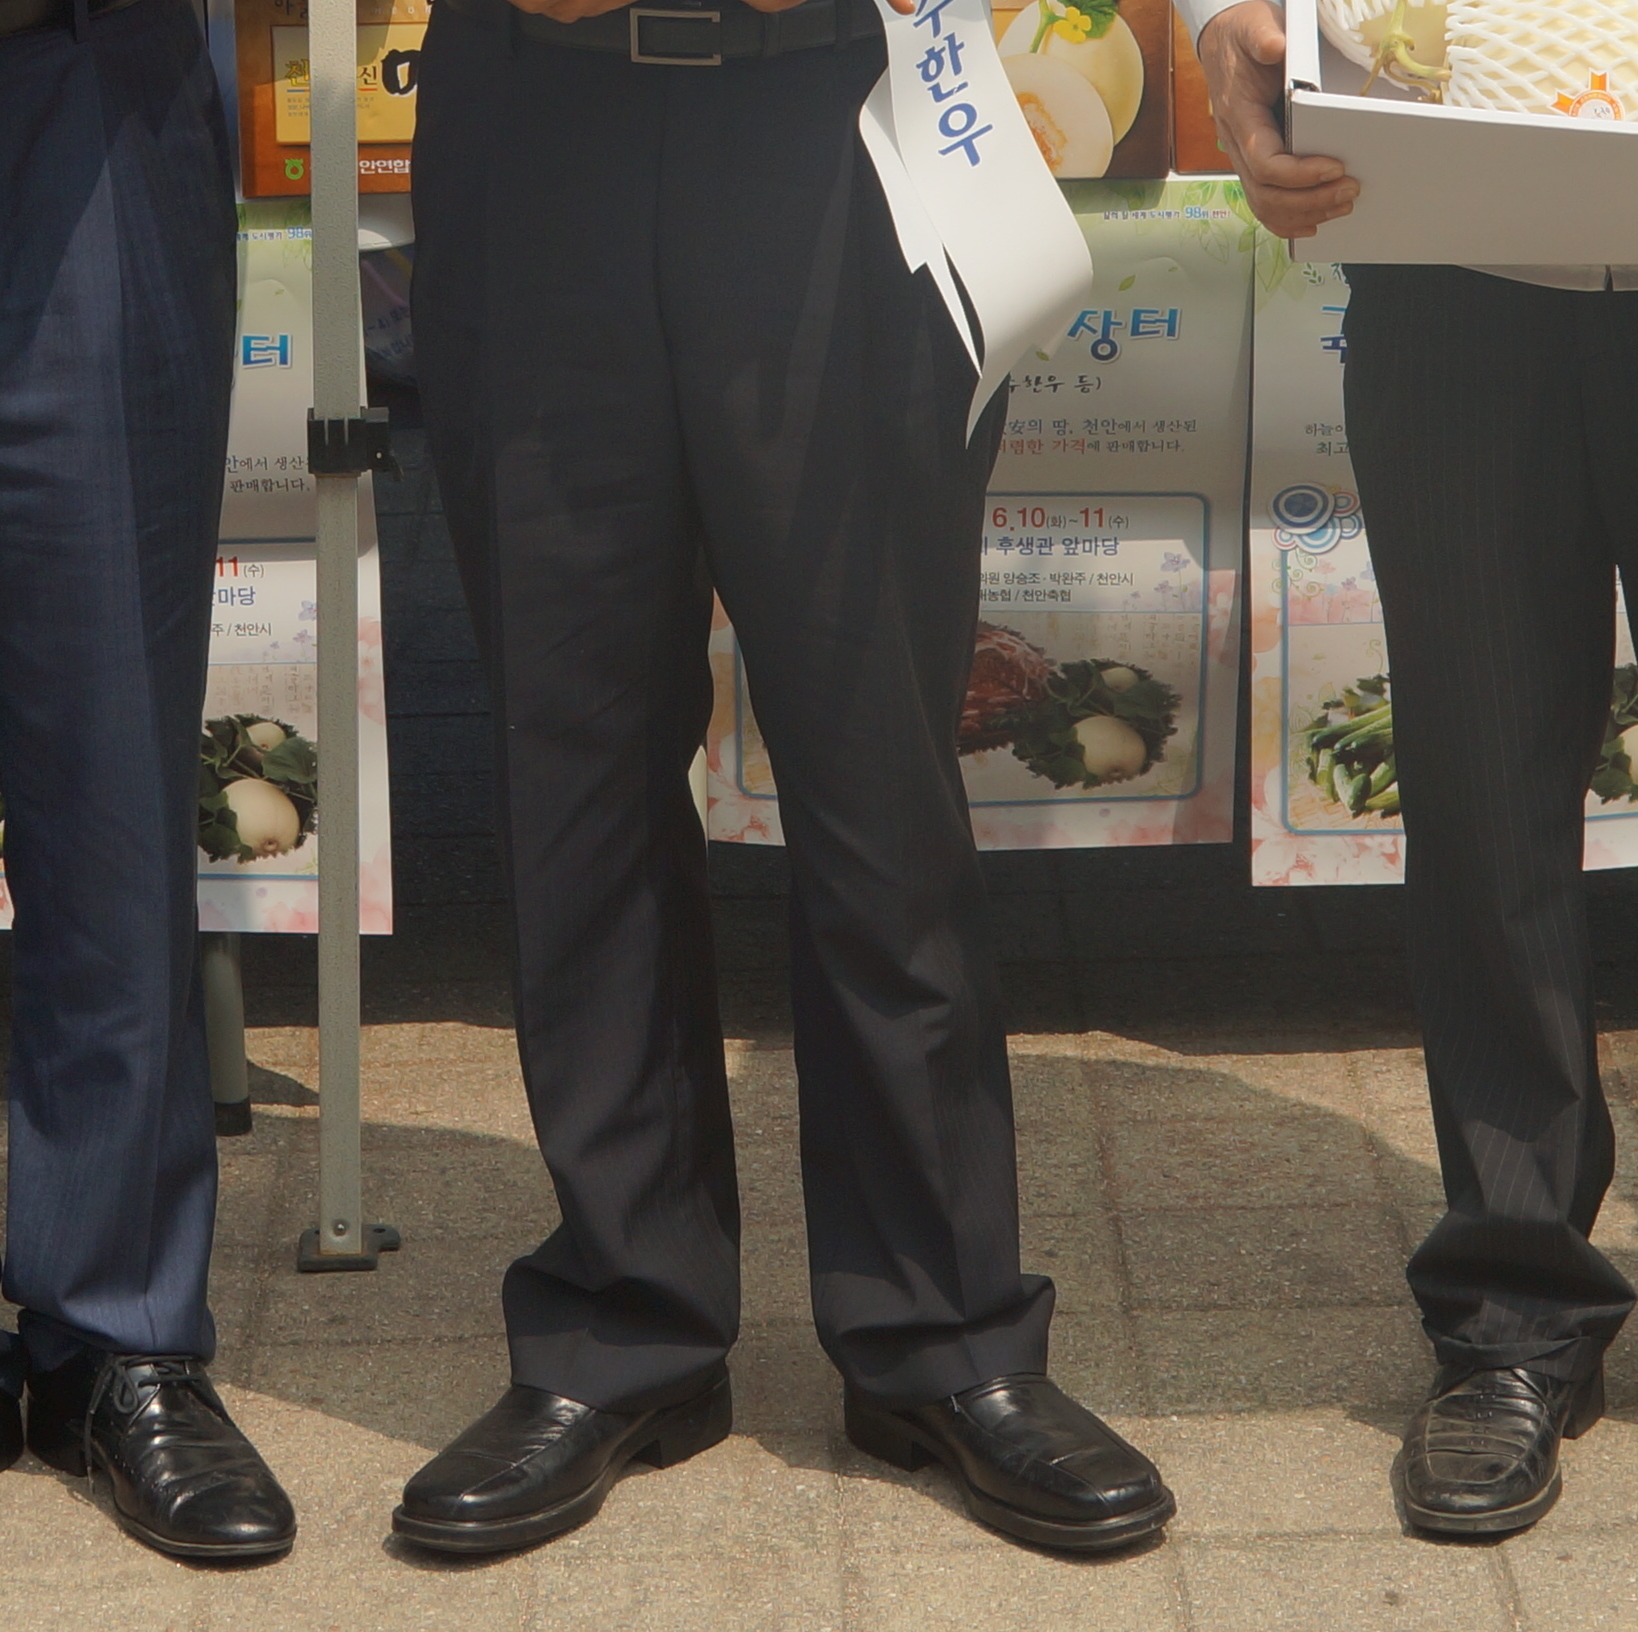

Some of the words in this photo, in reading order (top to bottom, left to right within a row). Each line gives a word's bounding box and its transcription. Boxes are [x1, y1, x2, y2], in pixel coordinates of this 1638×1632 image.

[996, 536, 1054, 556] 후생관
[1062, 536, 1120, 557] 앞마당
[1096, 572, 1134, 586] 천안시
[233, 622, 273, 637] 천안시
